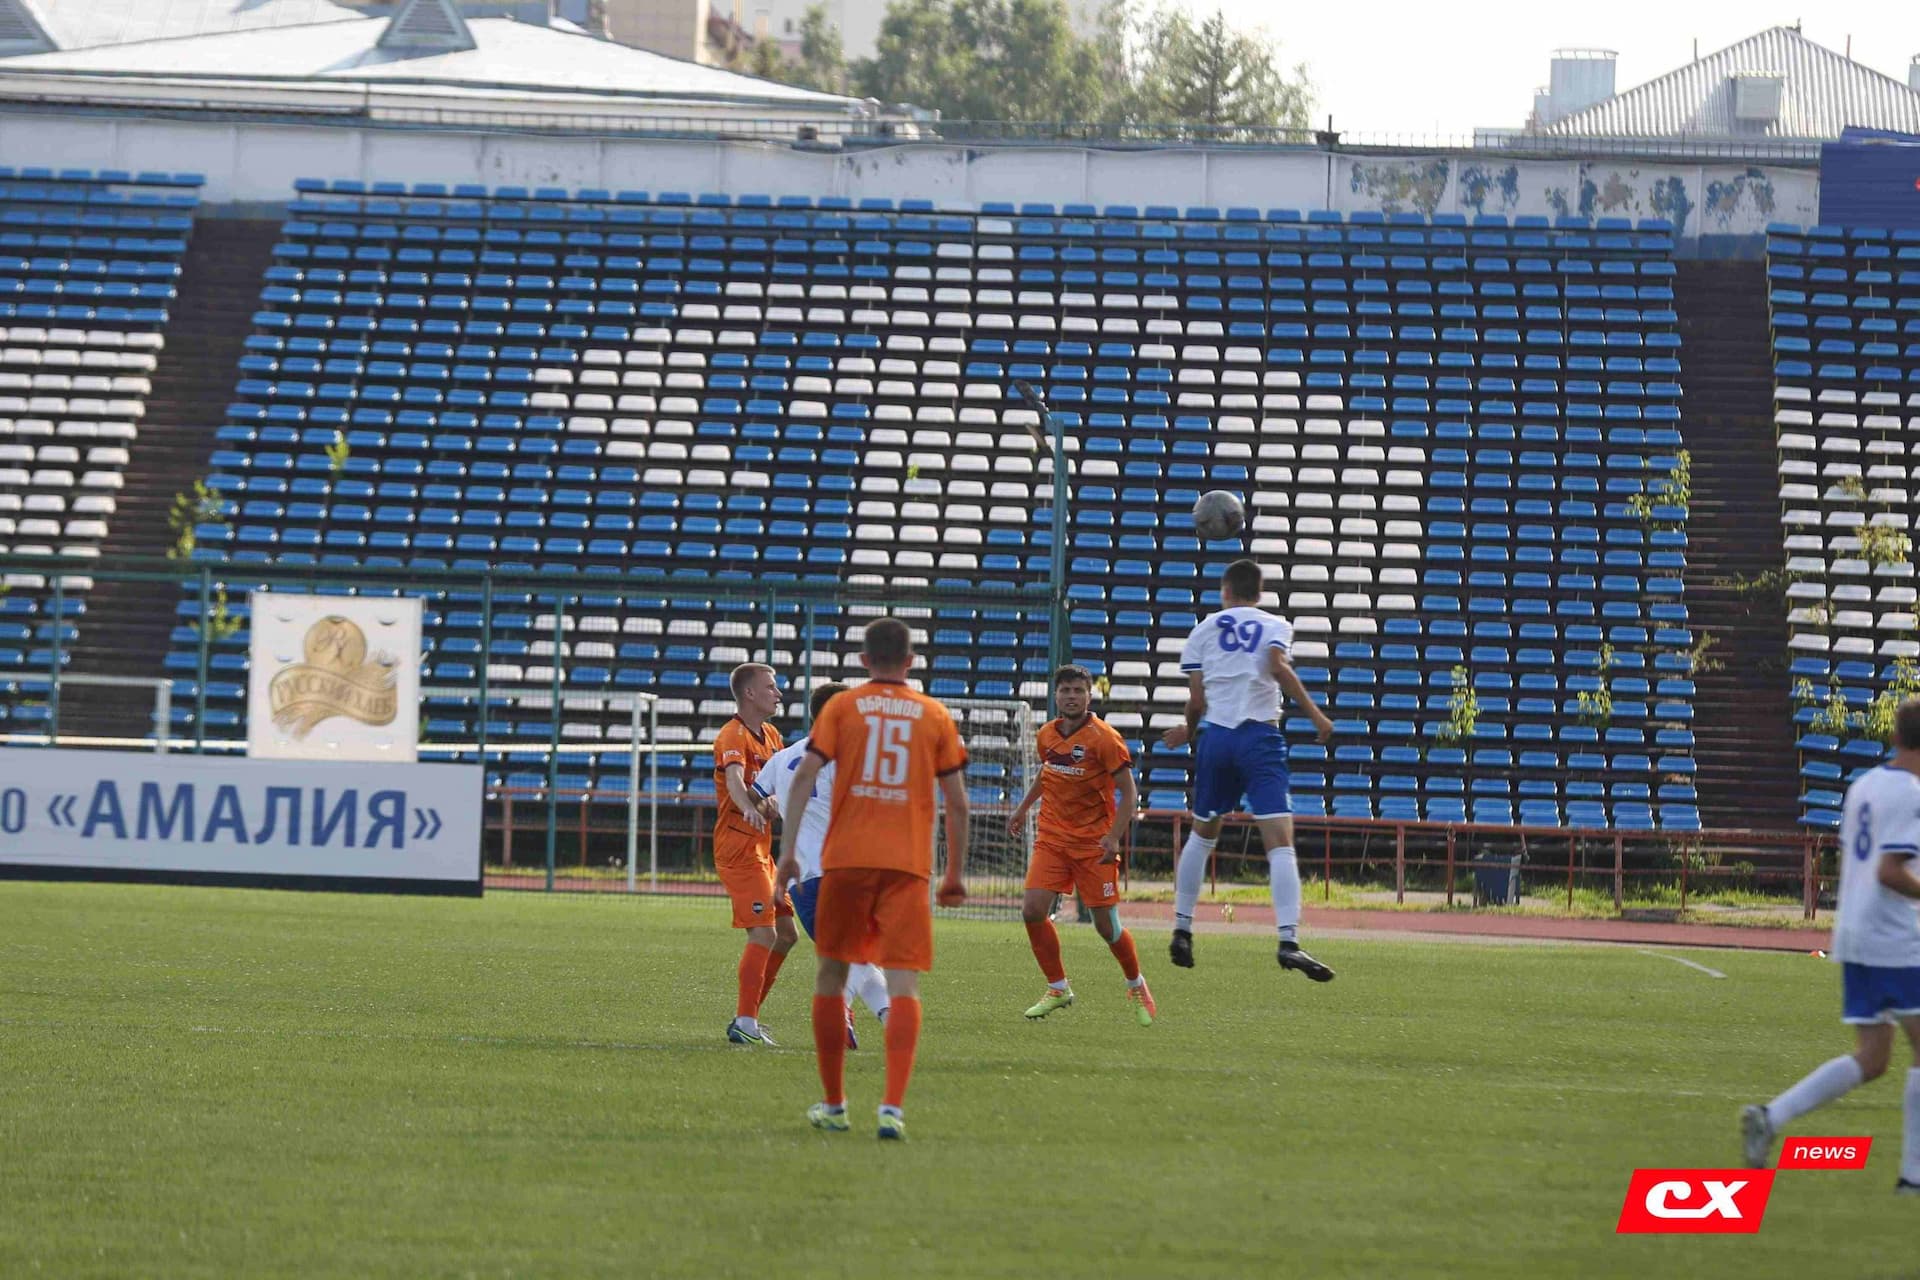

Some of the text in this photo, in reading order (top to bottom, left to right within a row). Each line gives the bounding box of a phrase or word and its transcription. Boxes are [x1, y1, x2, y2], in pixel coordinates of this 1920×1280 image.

[1216, 614, 1264, 653] 89
[863, 715, 912, 785] 15
[47, 779, 443, 849] «АМАЛИЯ»
[1855, 802, 1874, 861] 8
